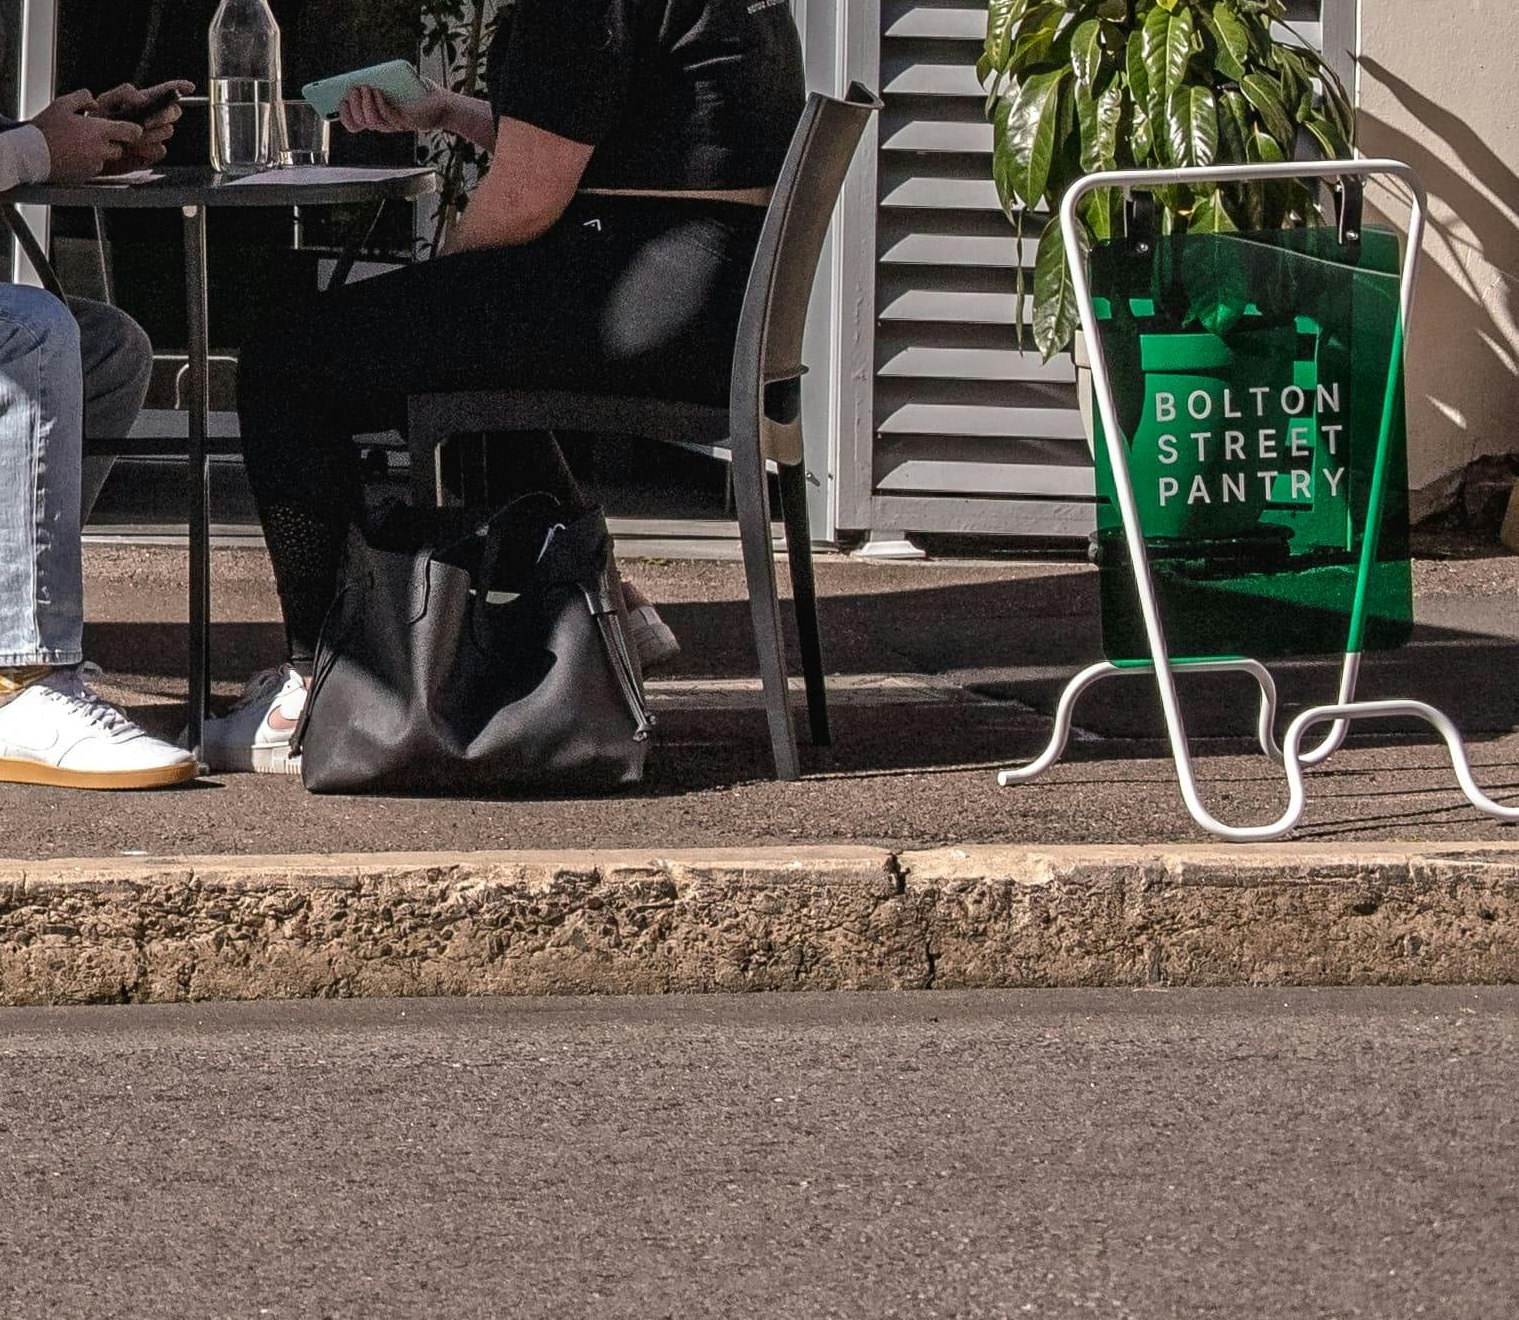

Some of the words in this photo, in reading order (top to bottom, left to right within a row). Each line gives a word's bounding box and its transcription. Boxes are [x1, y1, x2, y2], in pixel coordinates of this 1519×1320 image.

[1155, 382, 1341, 423] BOLTON
[1157, 423, 1344, 465] STREET
[1158, 466, 1345, 507] PANTRY
